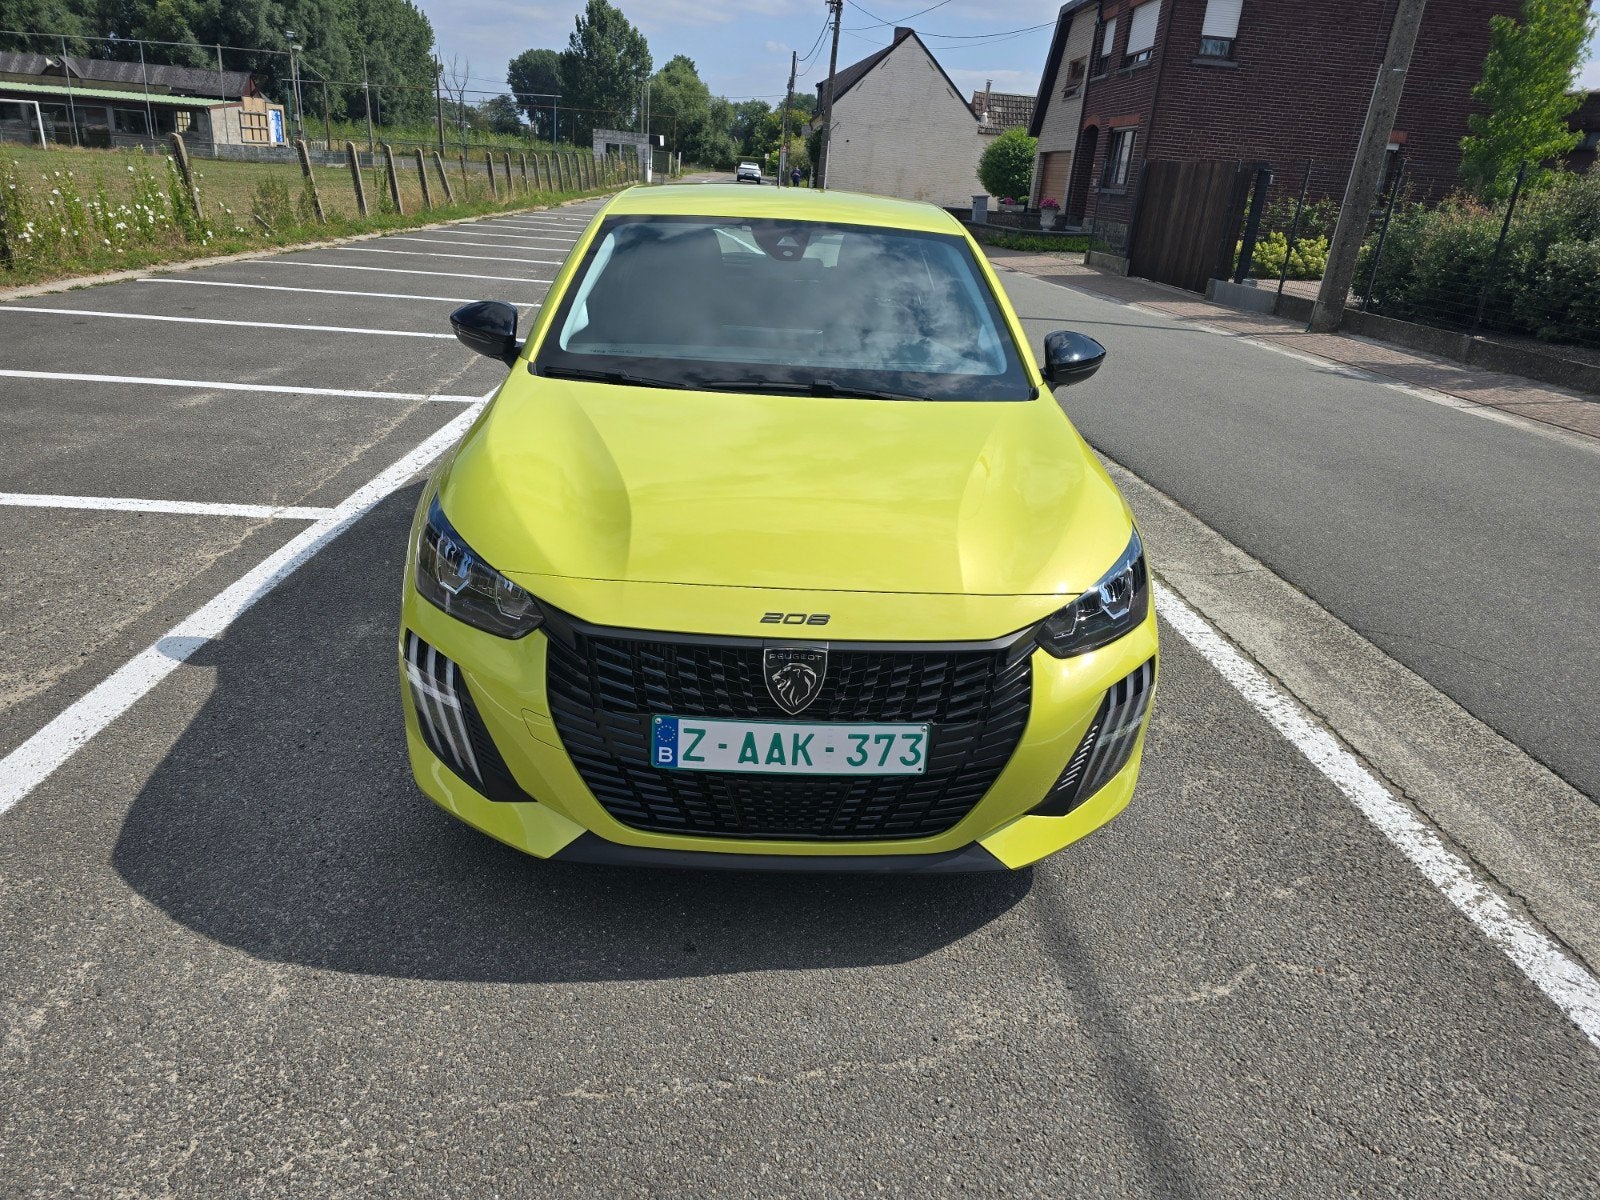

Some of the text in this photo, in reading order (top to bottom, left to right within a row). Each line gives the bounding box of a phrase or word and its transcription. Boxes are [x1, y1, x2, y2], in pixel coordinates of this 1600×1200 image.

[760, 612, 831, 626] 208
[769, 653, 822, 661] PEUGEOT
[658, 746, 673, 763] B
[682, 727, 924, 767] Z-AAK-373
